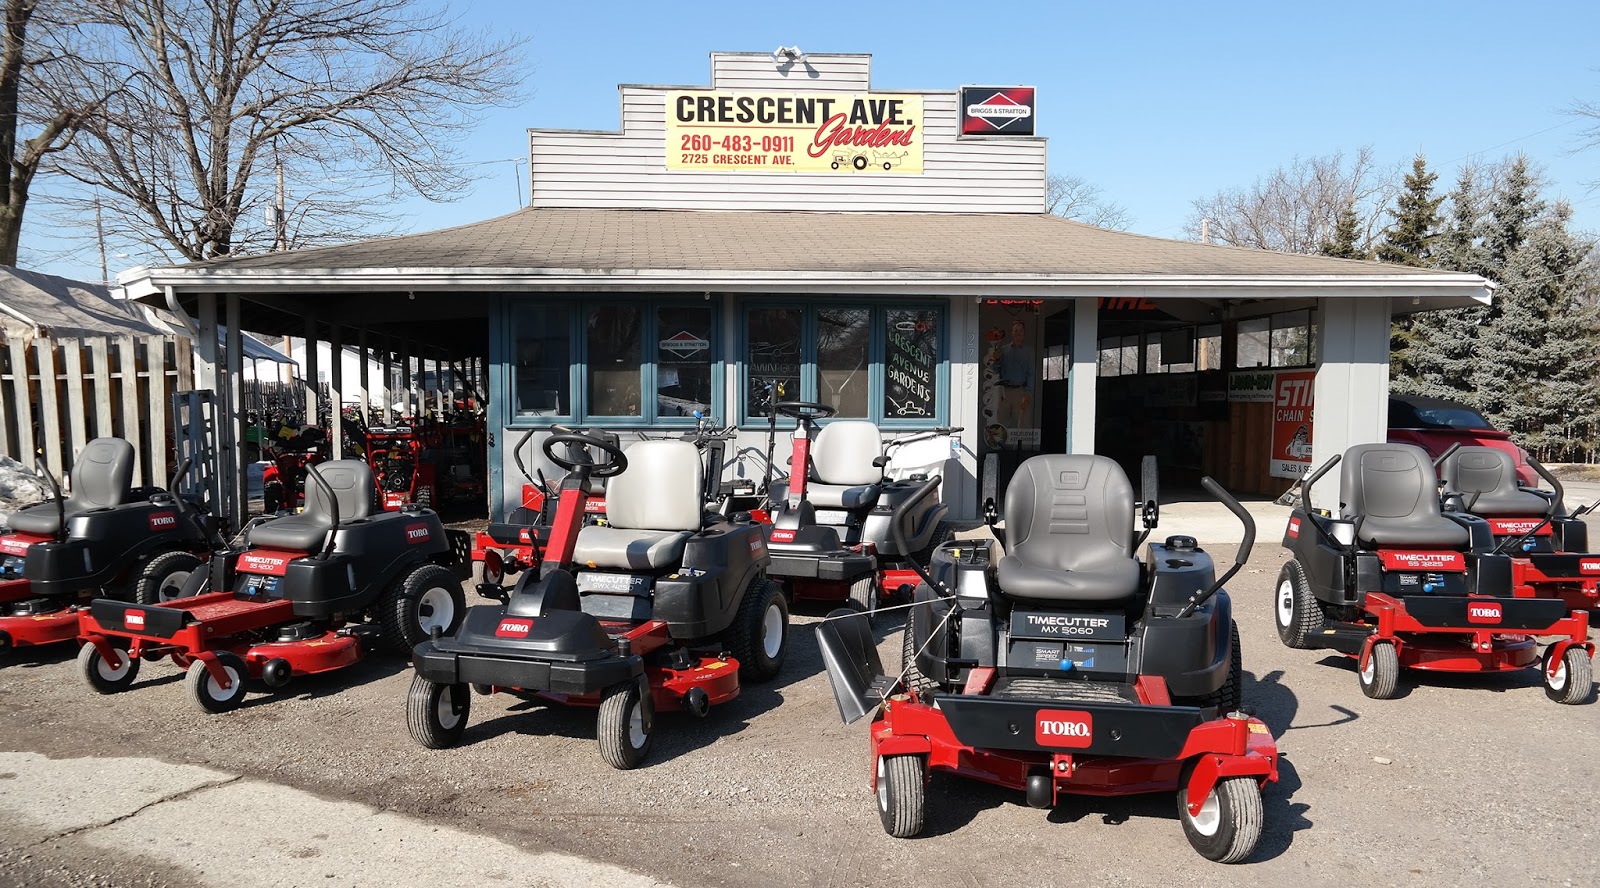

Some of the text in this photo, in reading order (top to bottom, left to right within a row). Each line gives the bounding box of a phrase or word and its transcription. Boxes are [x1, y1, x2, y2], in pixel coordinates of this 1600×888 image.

[676, 95, 913, 126] CRESCENT AVE.
[807, 112, 916, 158] Gardens
[681, 134, 795, 153] 260-483-0911
[681, 154, 795, 165] 2725 CRESCENT AVE.
[888, 331, 932, 368] CRESCENT
[892, 352, 930, 383] AVENUE
[887, 364, 931, 402] GARDENS
[1277, 409, 1304, 422] CHAIN
[1281, 463, 1297, 472] SALES
[244, 554, 284, 566] TIMECUTTER
[1394, 554, 1456, 562] TIMECUTTER
[585, 574, 643, 585] TIMECUTTER
[1027, 615, 1108, 628] TIMECUTTER
[1061, 627, 1094, 635] 5060
